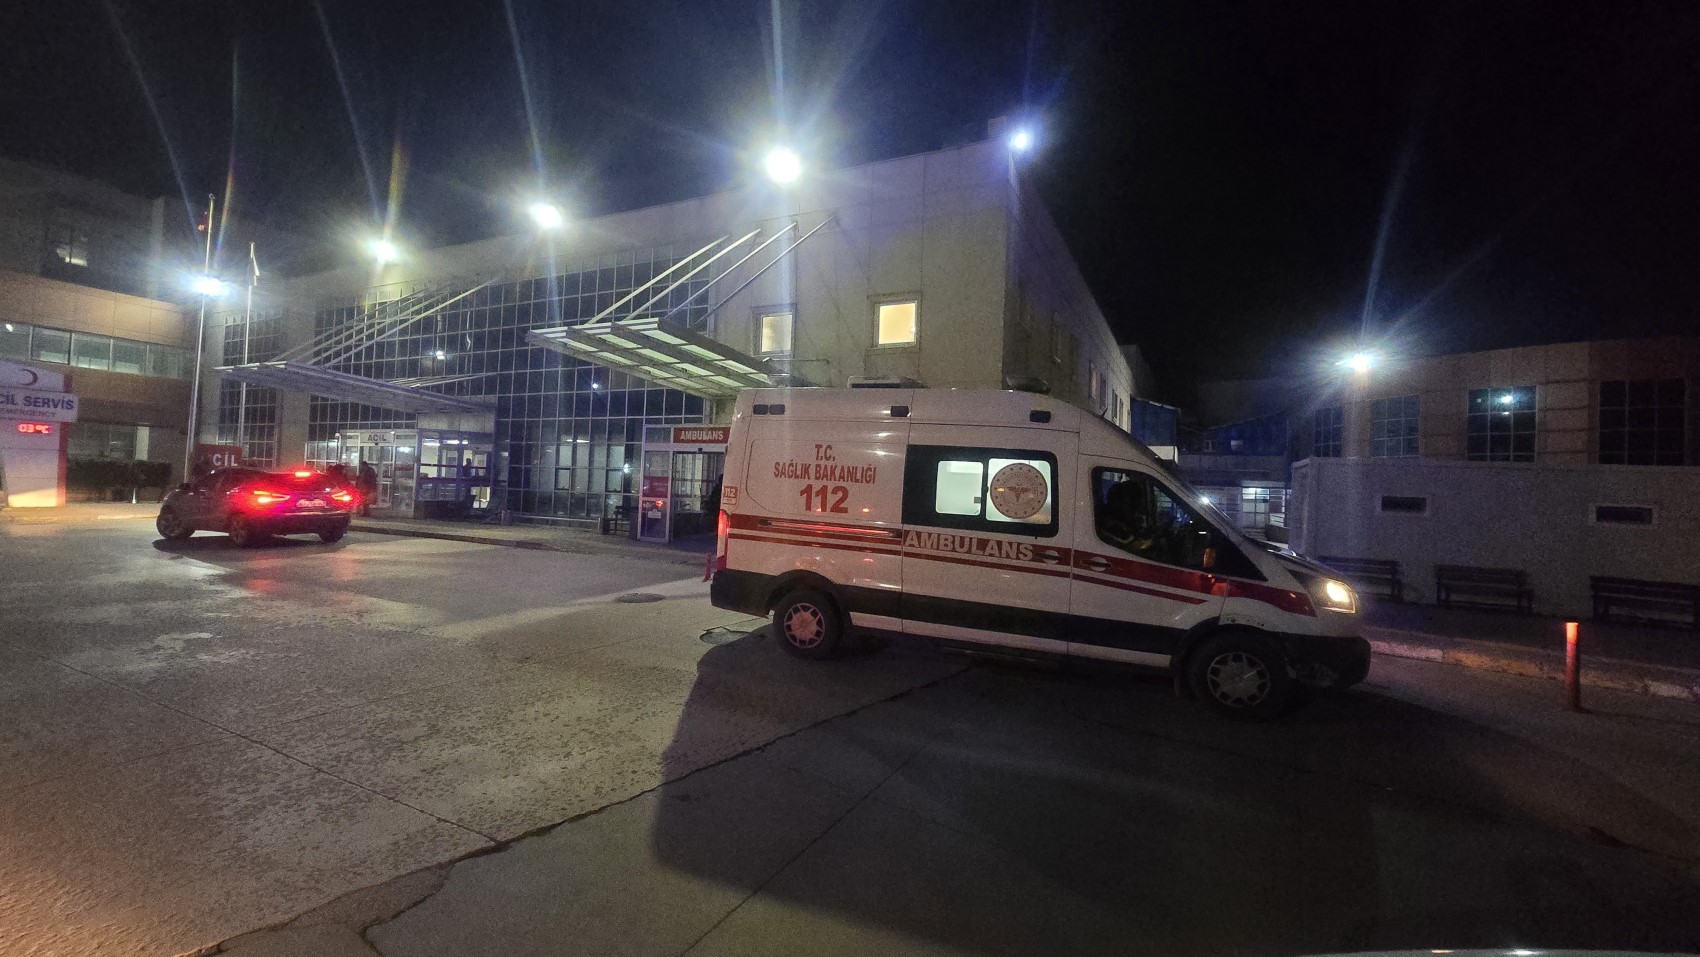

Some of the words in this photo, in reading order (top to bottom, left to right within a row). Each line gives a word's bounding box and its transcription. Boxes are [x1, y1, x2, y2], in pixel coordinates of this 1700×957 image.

[23, 395, 74, 410] SERVİS
[680, 430, 724, 440] AMBULANS
[814, 443, 836, 461] T.C.
[773, 459, 811, 480] SAĞLIK
[814, 463, 877, 484] BAKANLIĞI
[724, 487, 736, 497] 112
[799, 483, 849, 513] 112
[905, 530, 1034, 561] AMBULANS
